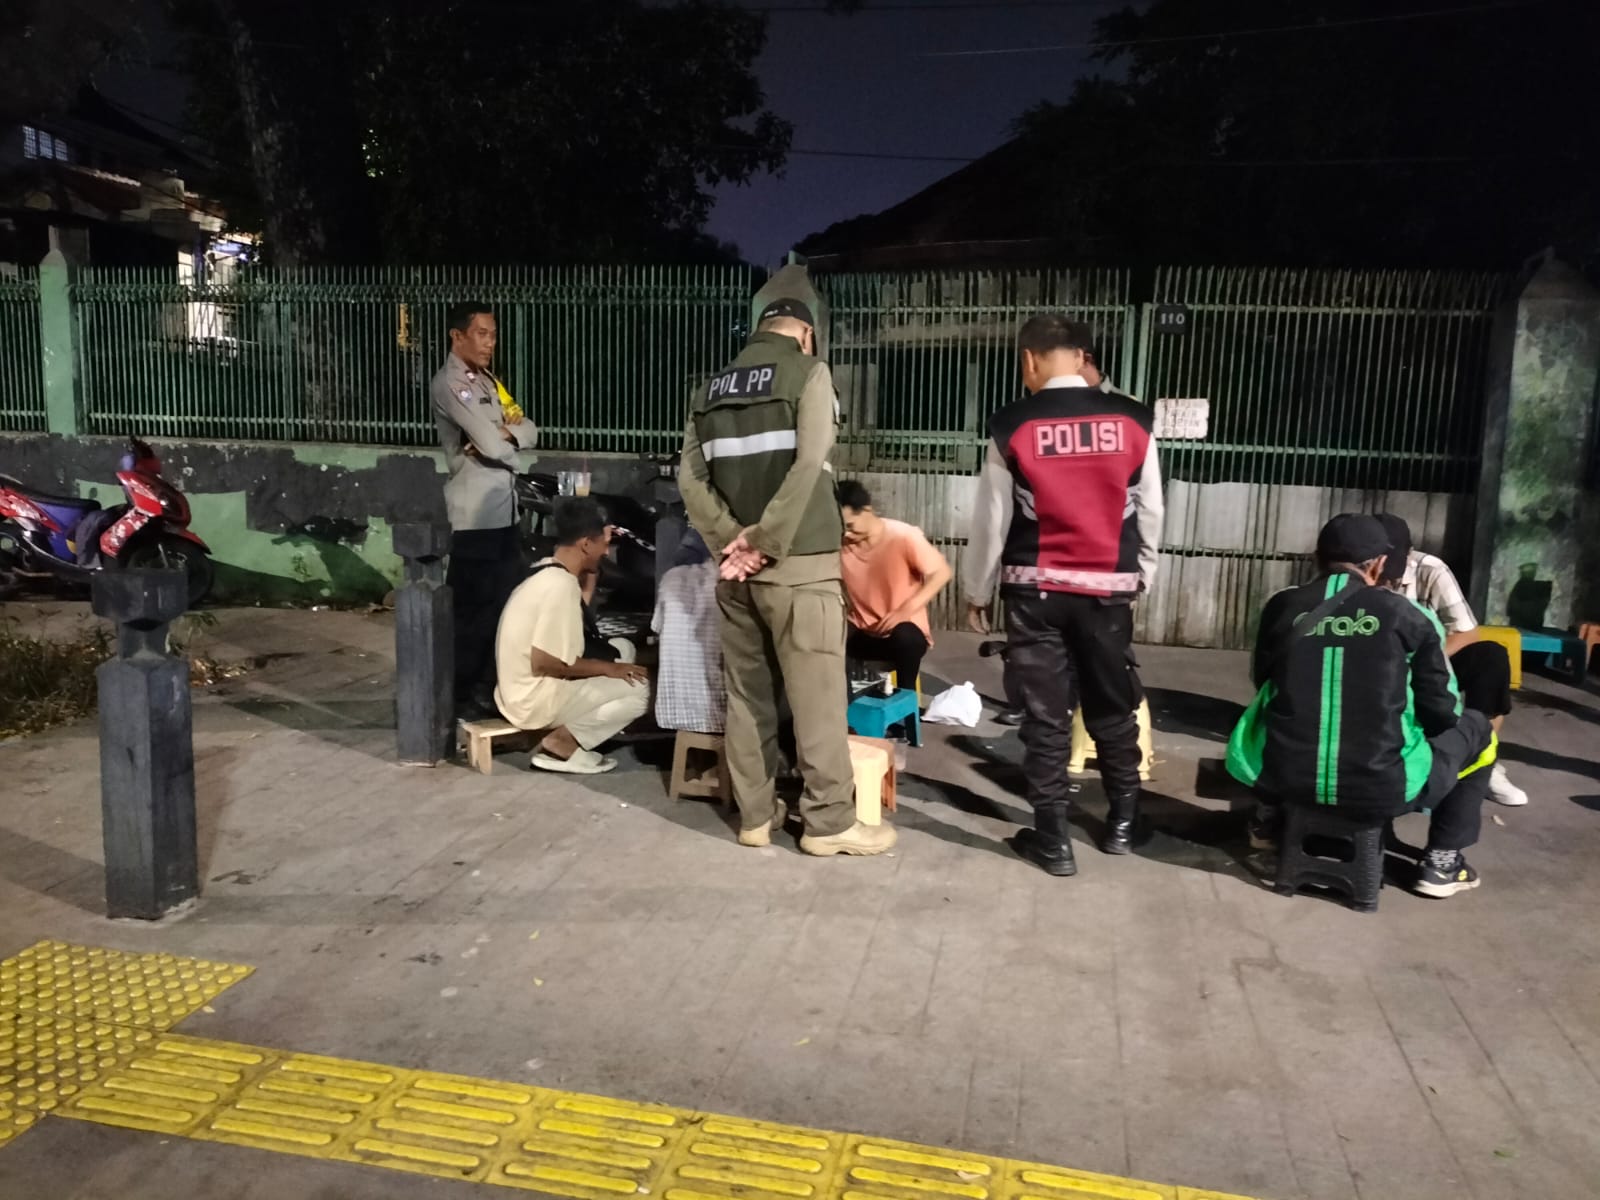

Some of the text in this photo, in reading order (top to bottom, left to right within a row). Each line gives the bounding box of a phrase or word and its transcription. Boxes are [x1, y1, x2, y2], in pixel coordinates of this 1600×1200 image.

[1160, 312, 1185, 325] 110
[708, 367, 772, 400] POL PP
[1036, 421, 1124, 456] POLISI
